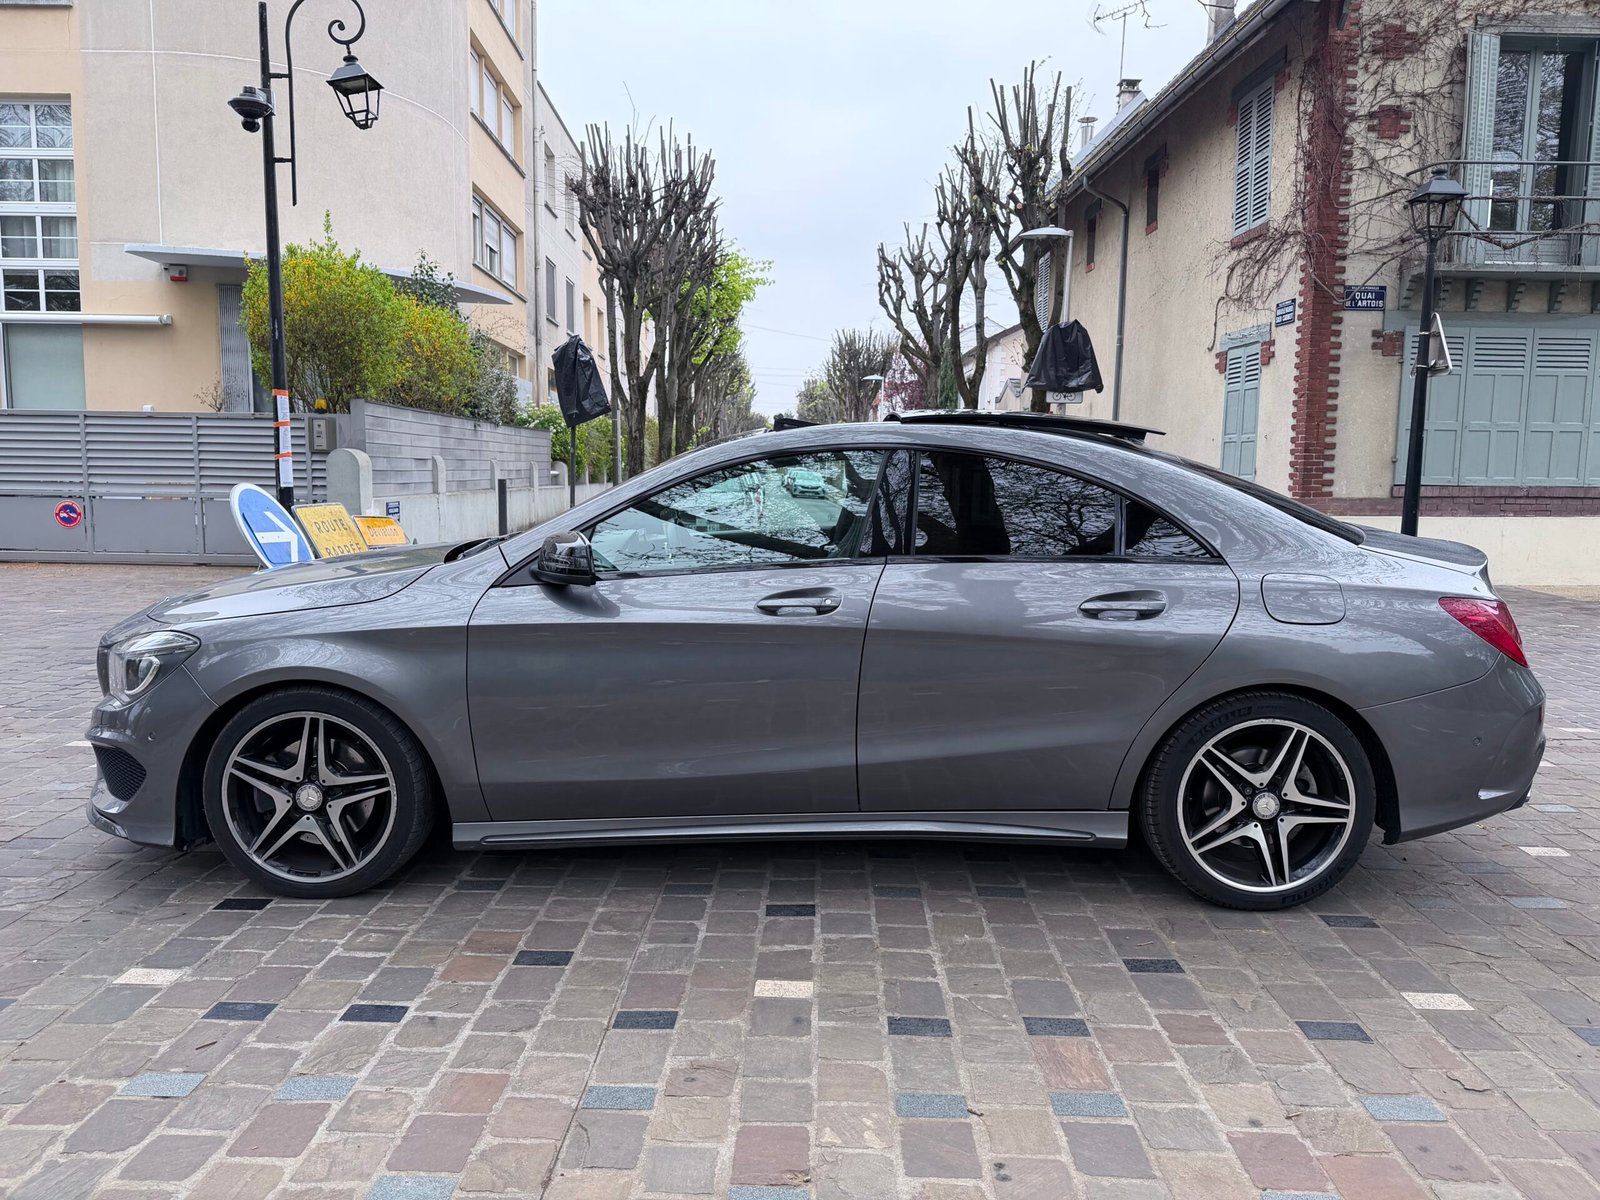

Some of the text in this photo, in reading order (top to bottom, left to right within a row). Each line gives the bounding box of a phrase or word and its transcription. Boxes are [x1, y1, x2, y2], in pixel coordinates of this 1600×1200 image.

[1355, 292, 1375, 300] QUAI
[1352, 299, 1384, 308] L'ARTOIS
[314, 518, 348, 534] ROUTE
